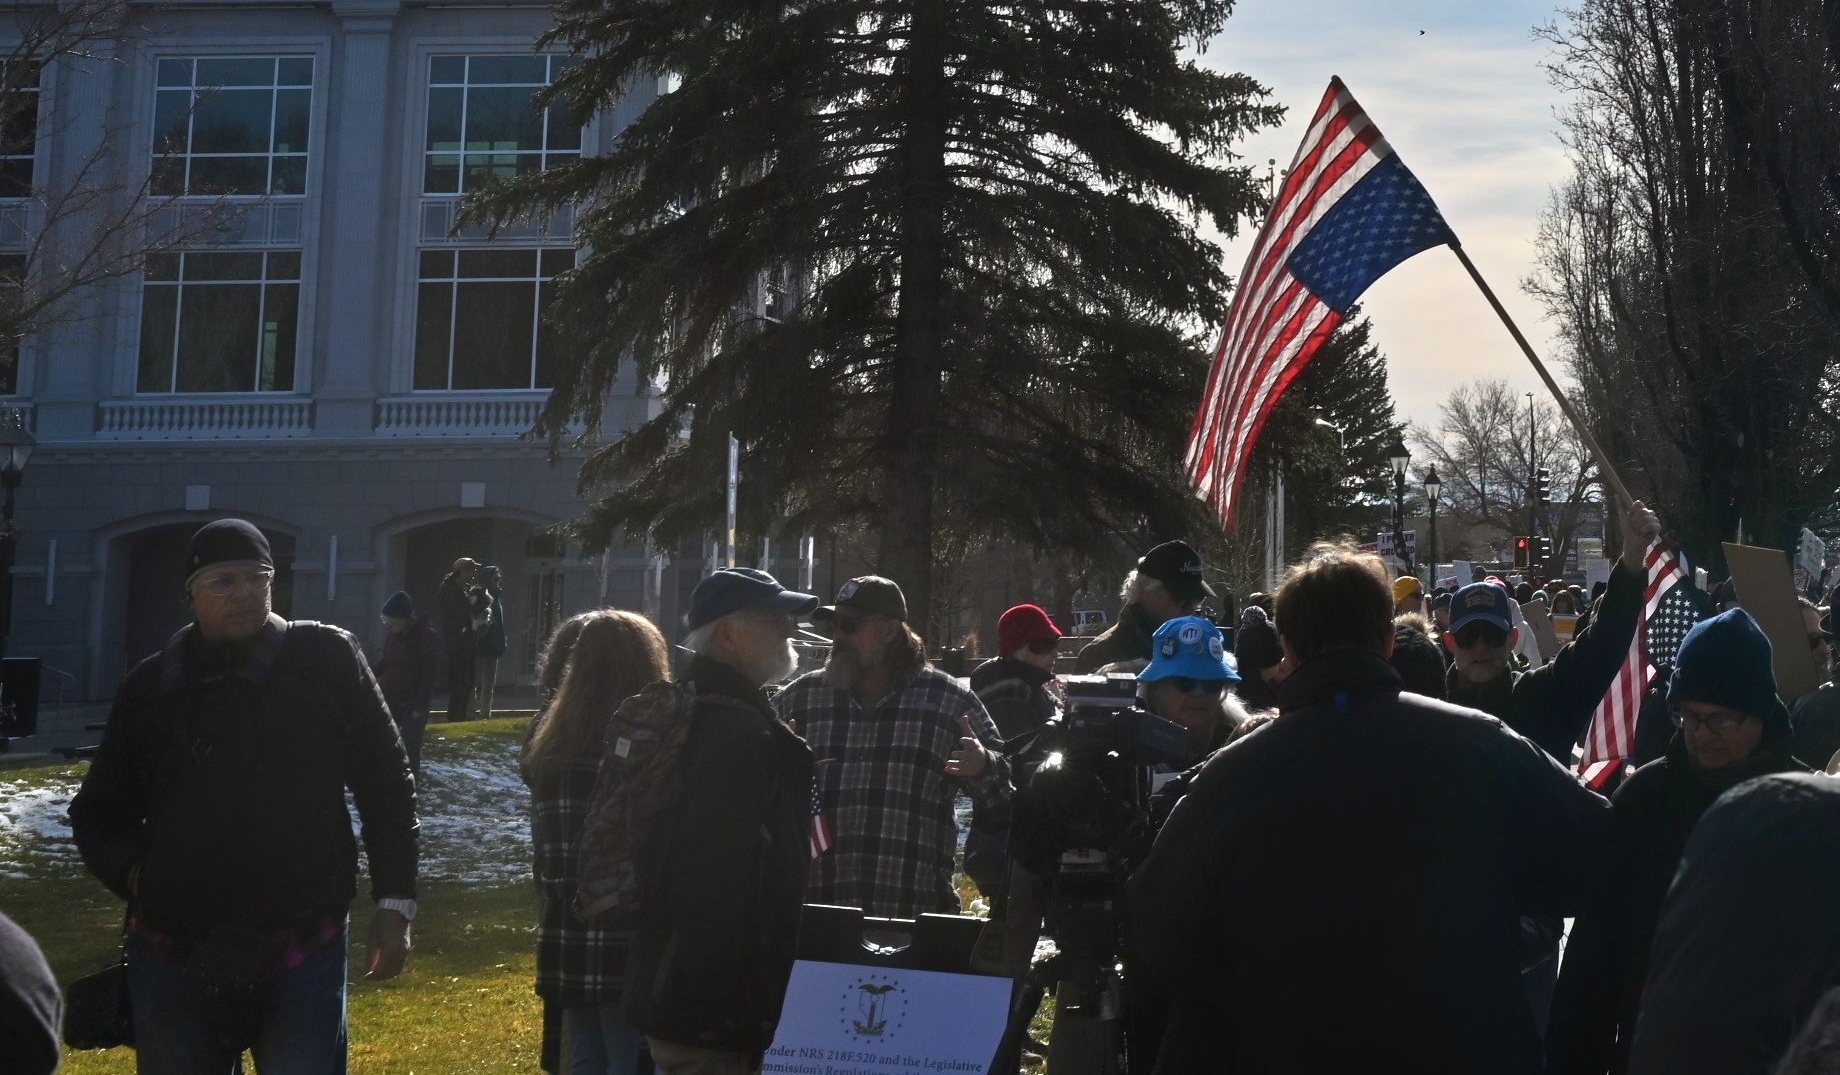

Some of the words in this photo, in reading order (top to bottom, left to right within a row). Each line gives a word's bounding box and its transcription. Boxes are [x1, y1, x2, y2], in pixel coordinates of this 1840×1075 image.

[762, 1063, 823, 1075] mmission's
[799, 1047, 824, 1059] NRS
[827, 1050, 876, 1064] 218F.520
[879, 1054, 900, 1066] and
[903, 1055, 920, 1067] the
[923, 1057, 982, 1074] Legislative
